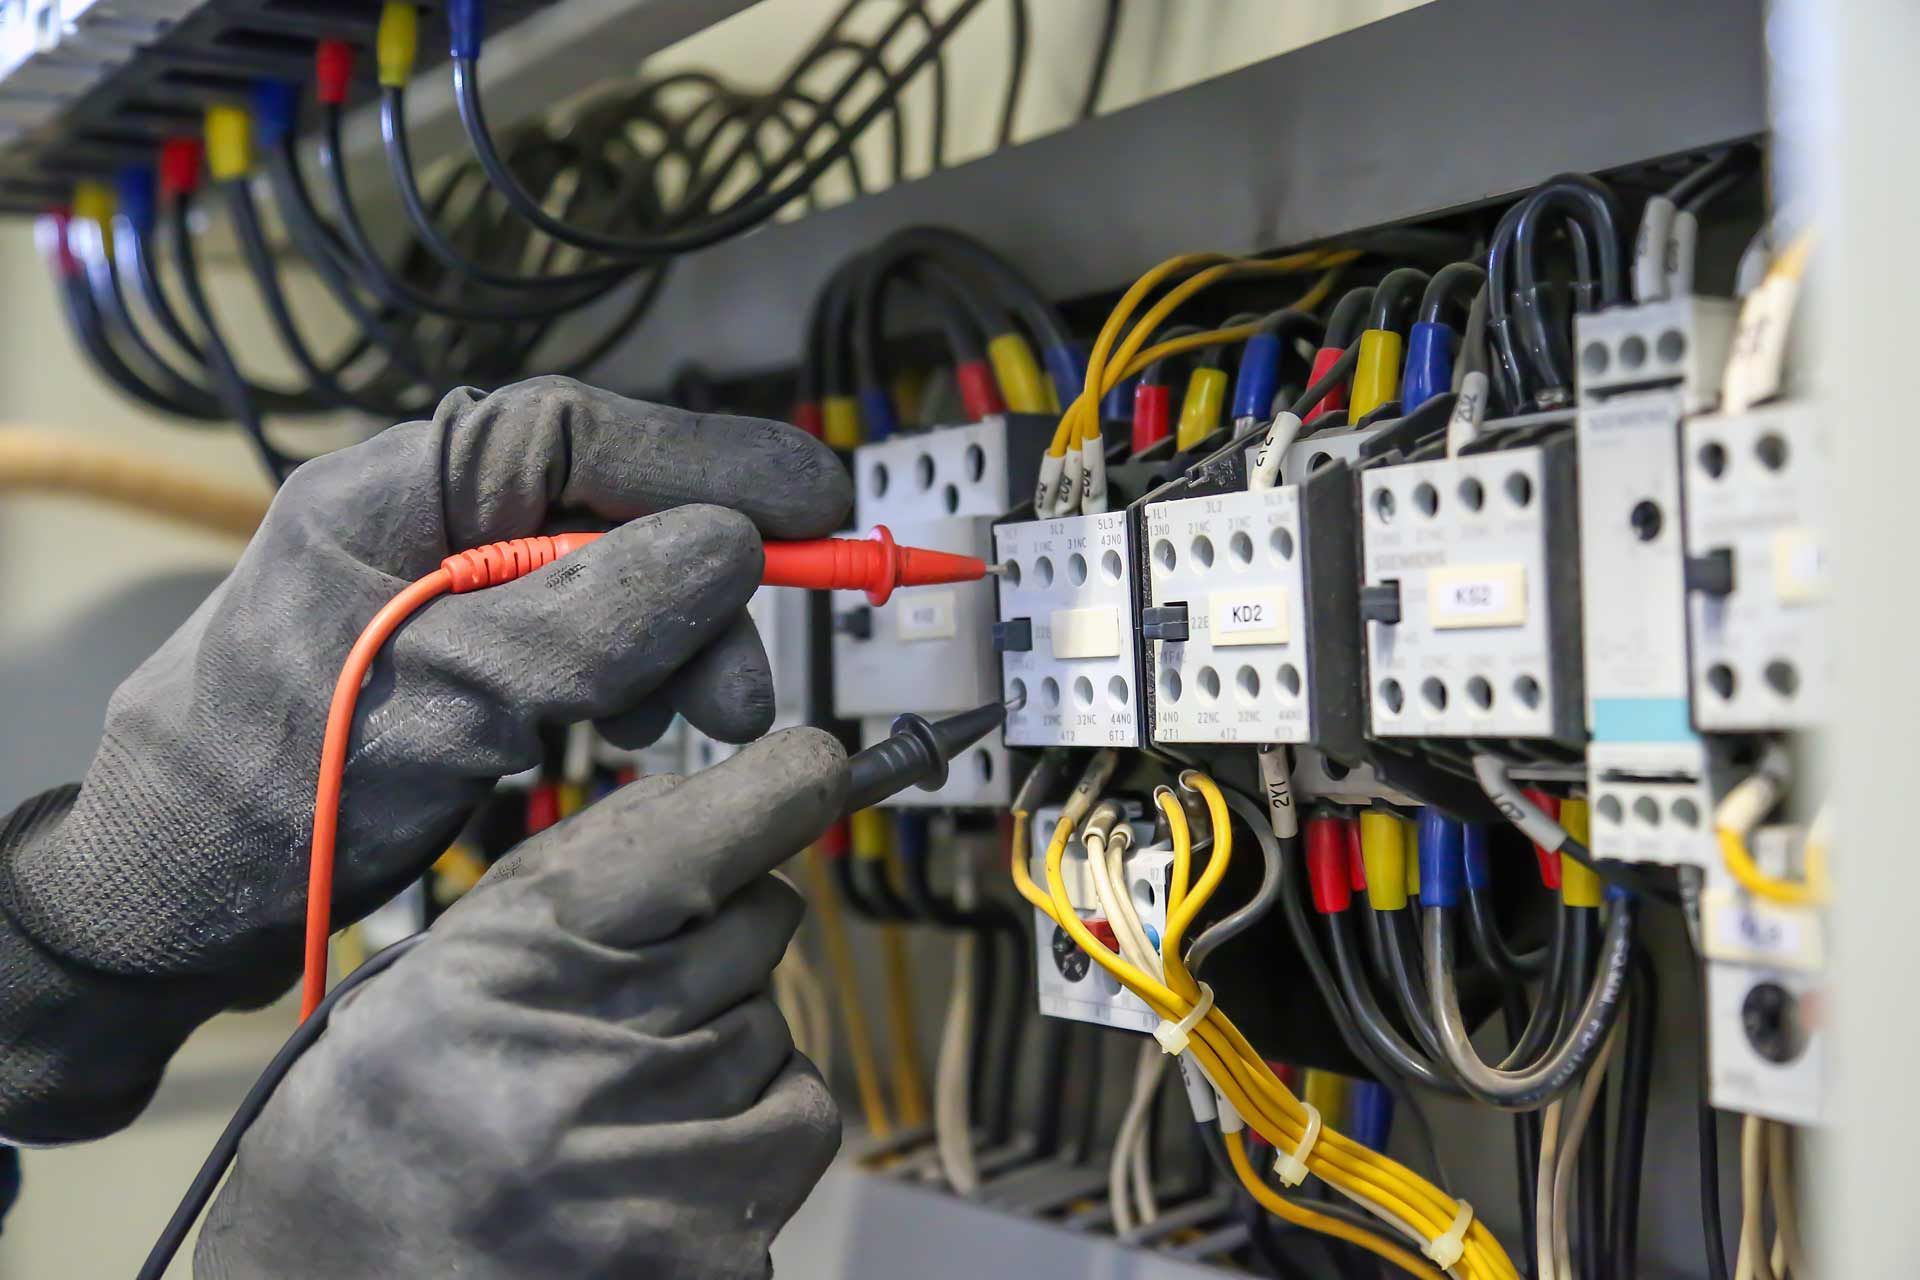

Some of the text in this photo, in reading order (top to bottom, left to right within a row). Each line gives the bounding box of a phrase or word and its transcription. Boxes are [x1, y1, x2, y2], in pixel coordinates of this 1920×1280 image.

[1206, 501, 1223, 513] 3L2
[1153, 508, 1168, 519] 1L1
[1067, 537, 1088, 549] 31NC
[1101, 534, 1122, 546] 43NO
[1232, 605, 1263, 623] KD2
[1191, 617, 1209, 629] 22E
[1111, 714, 1132, 725] 44NO
[1197, 712, 1221, 724] 22NC
[1109, 730, 1125, 742] 6T3
[1163, 729, 1179, 740] 2T1
[1220, 728, 1238, 740] 4T2
[1269, 781, 1290, 808] 2Y1
